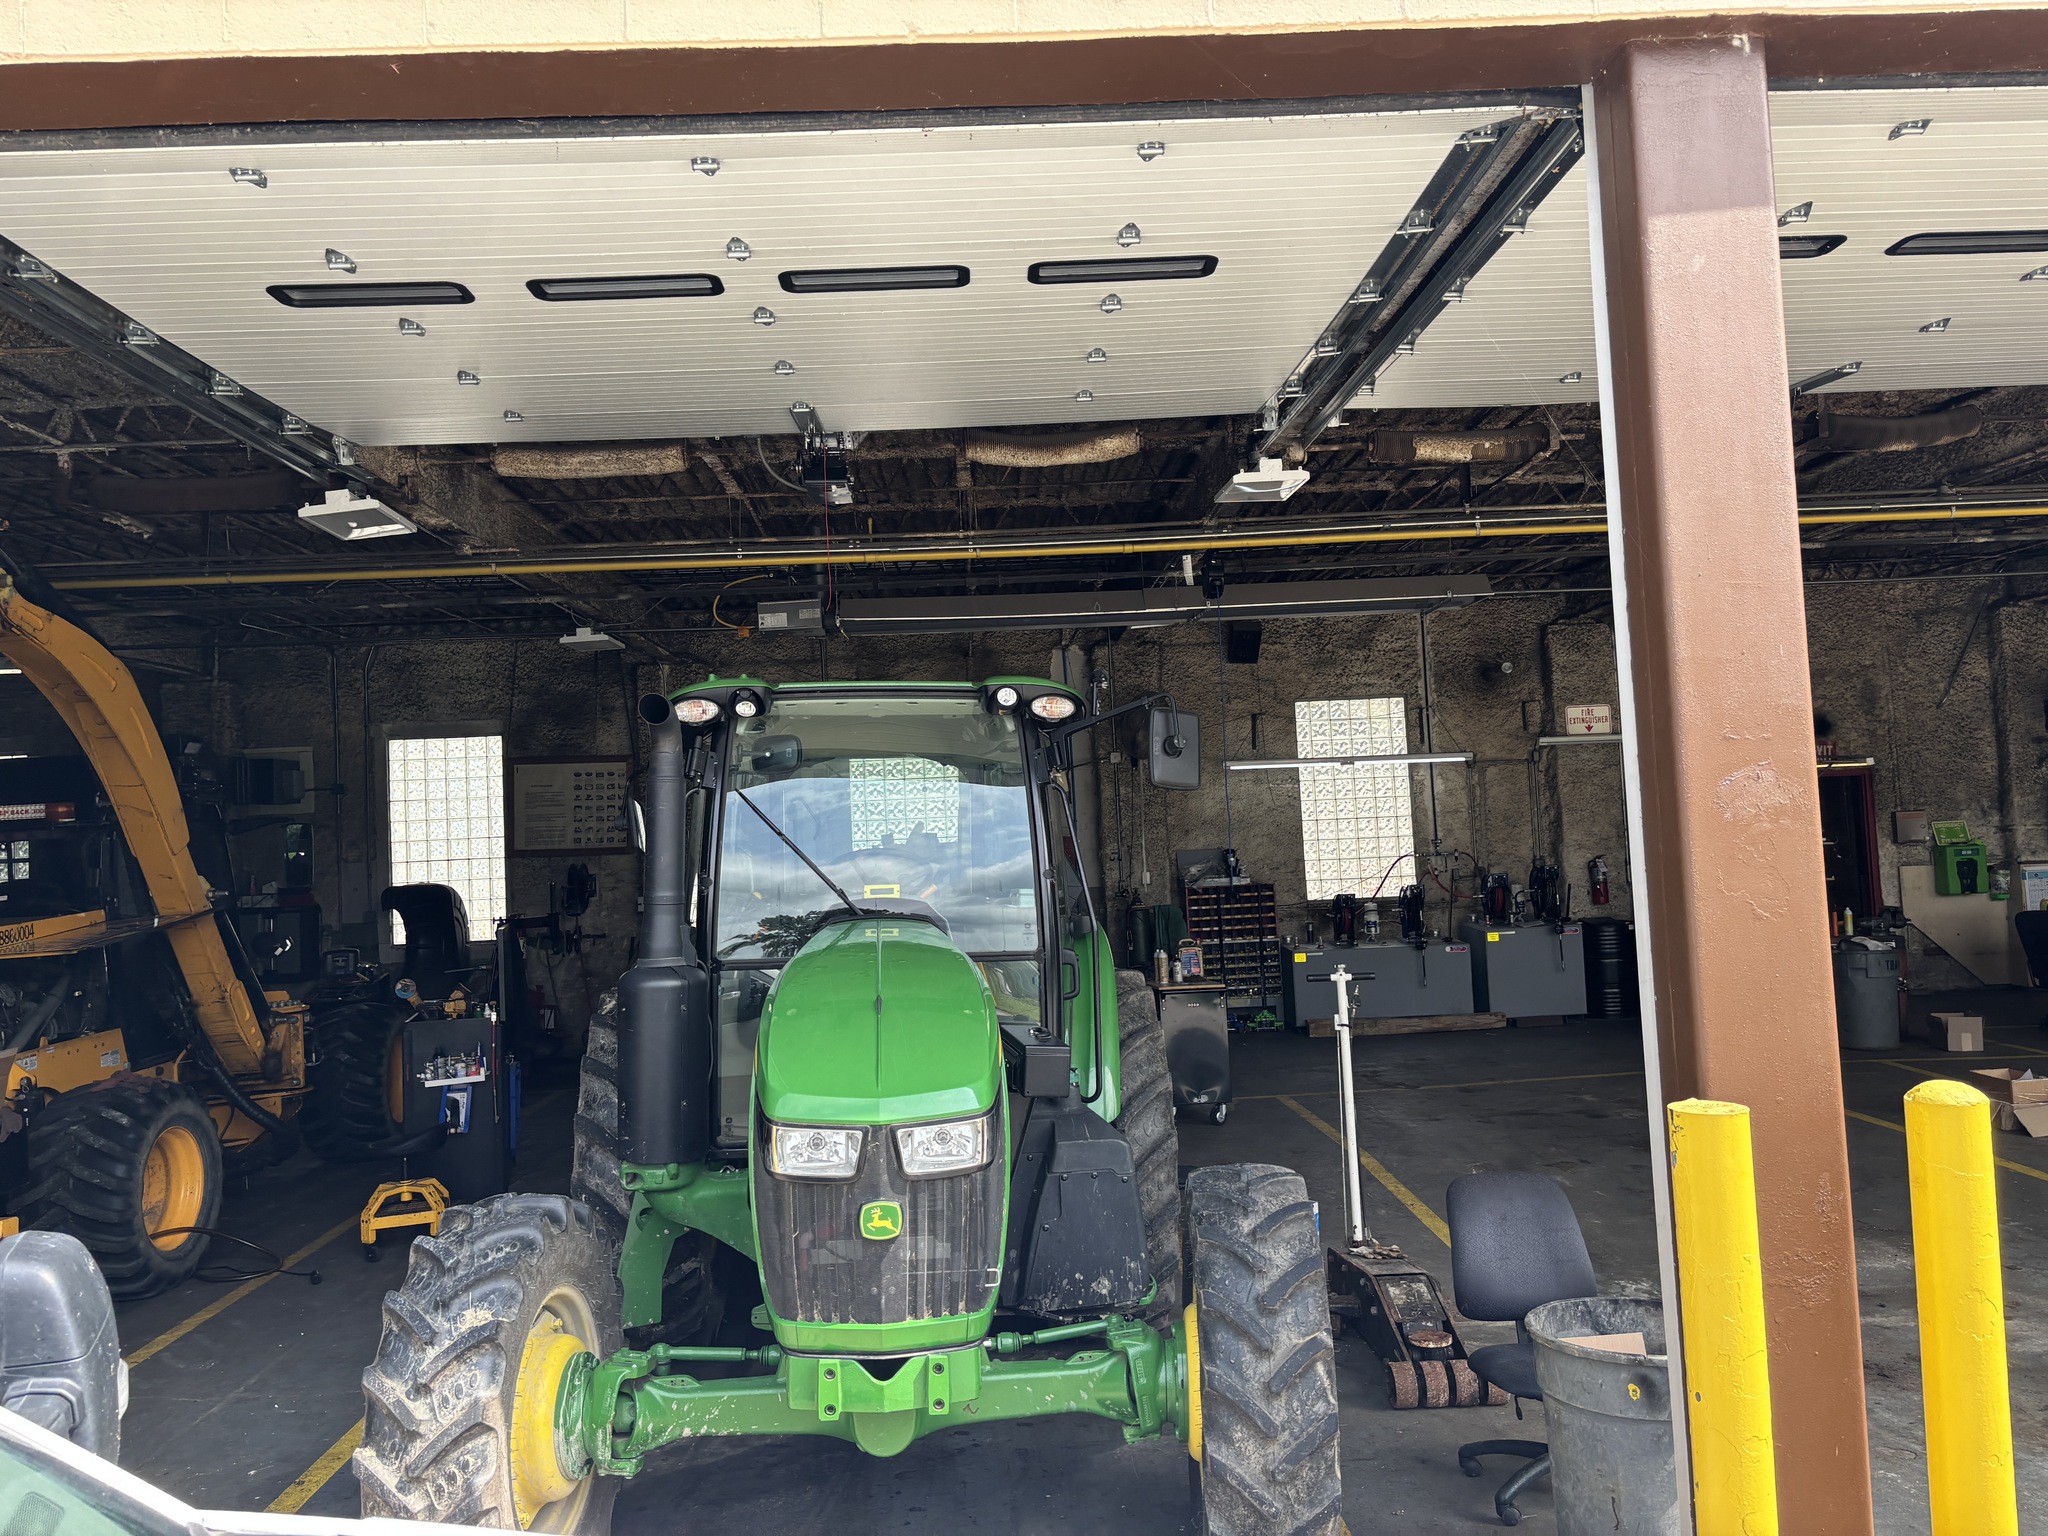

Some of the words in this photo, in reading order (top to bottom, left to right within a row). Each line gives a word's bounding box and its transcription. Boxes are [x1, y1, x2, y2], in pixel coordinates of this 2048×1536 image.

[1581, 708, 1595, 717] FIRE
[1569, 716, 1609, 725] EXTINGUISHER
[10, 808, 30, 816] BACK
